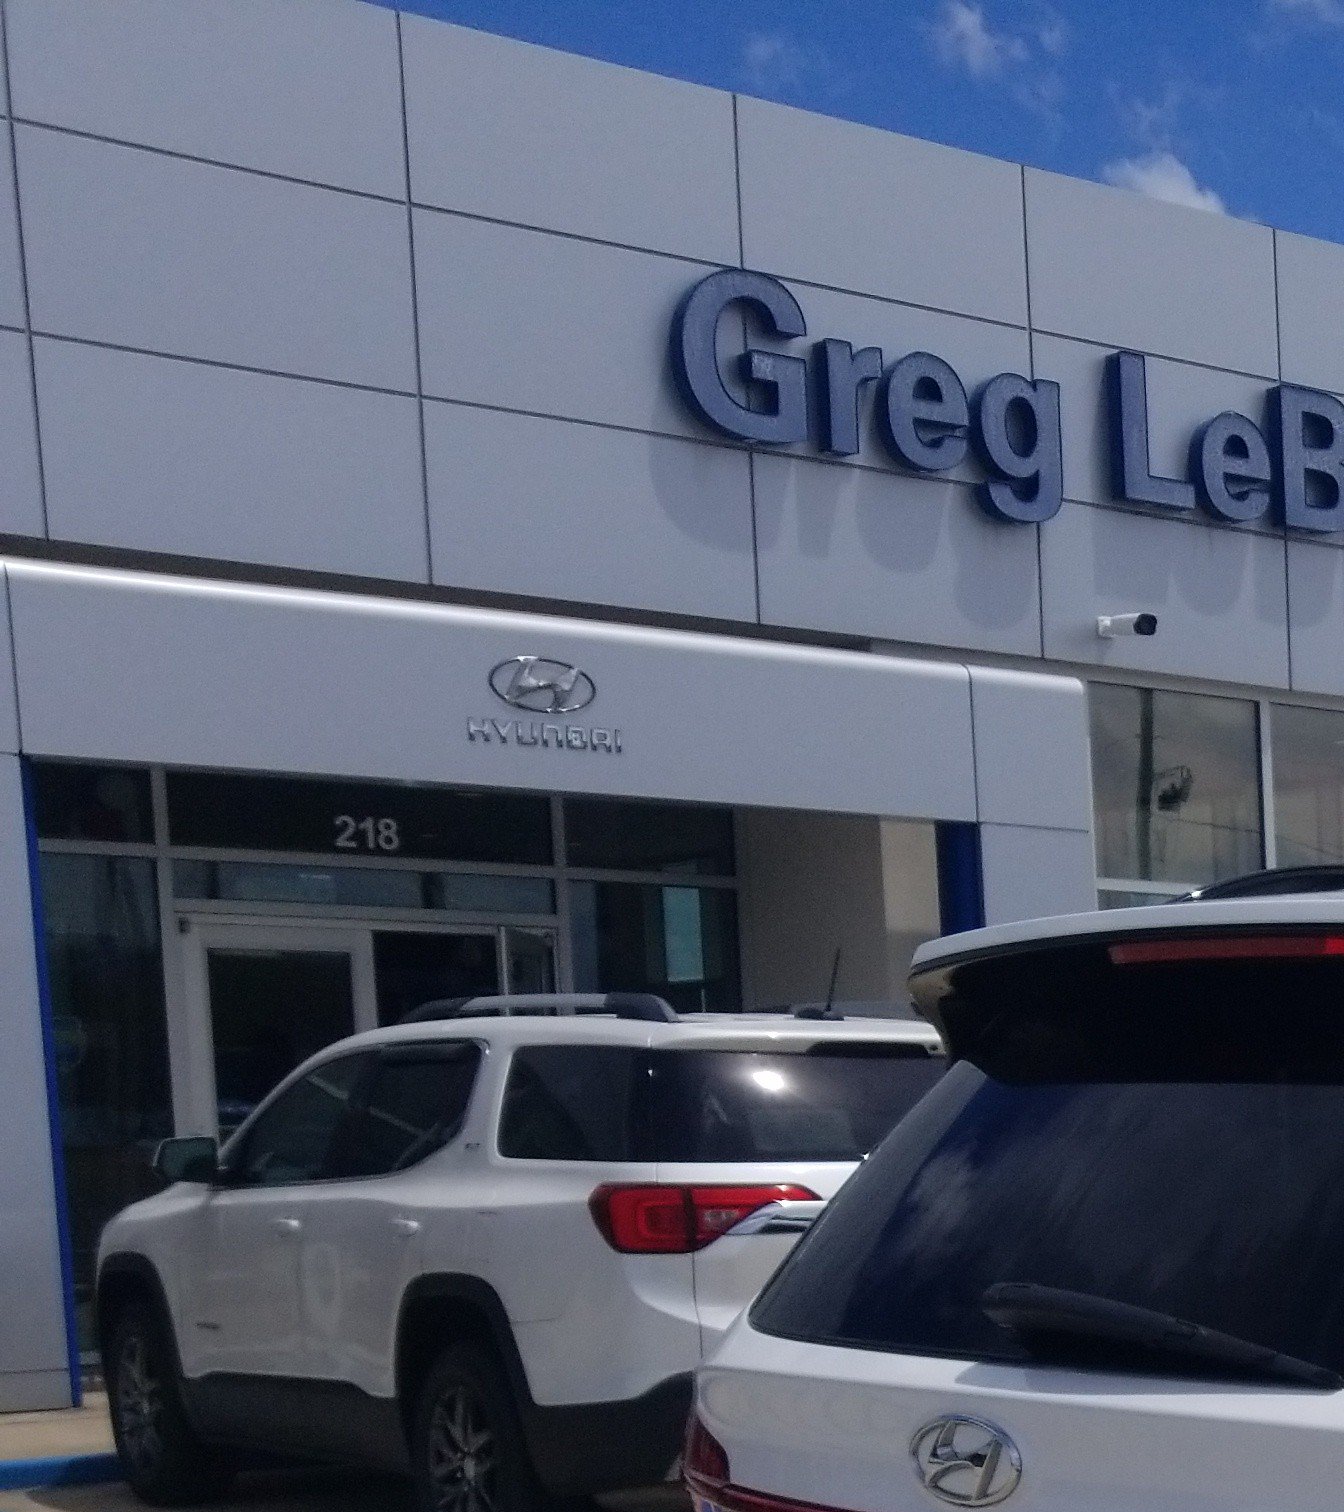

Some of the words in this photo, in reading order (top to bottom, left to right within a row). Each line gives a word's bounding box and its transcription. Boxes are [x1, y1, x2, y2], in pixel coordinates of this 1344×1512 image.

[670, 268, 1063, 524] Greg
[466, 716, 622, 753] HYUNDAI
[334, 815, 400, 850] 218
